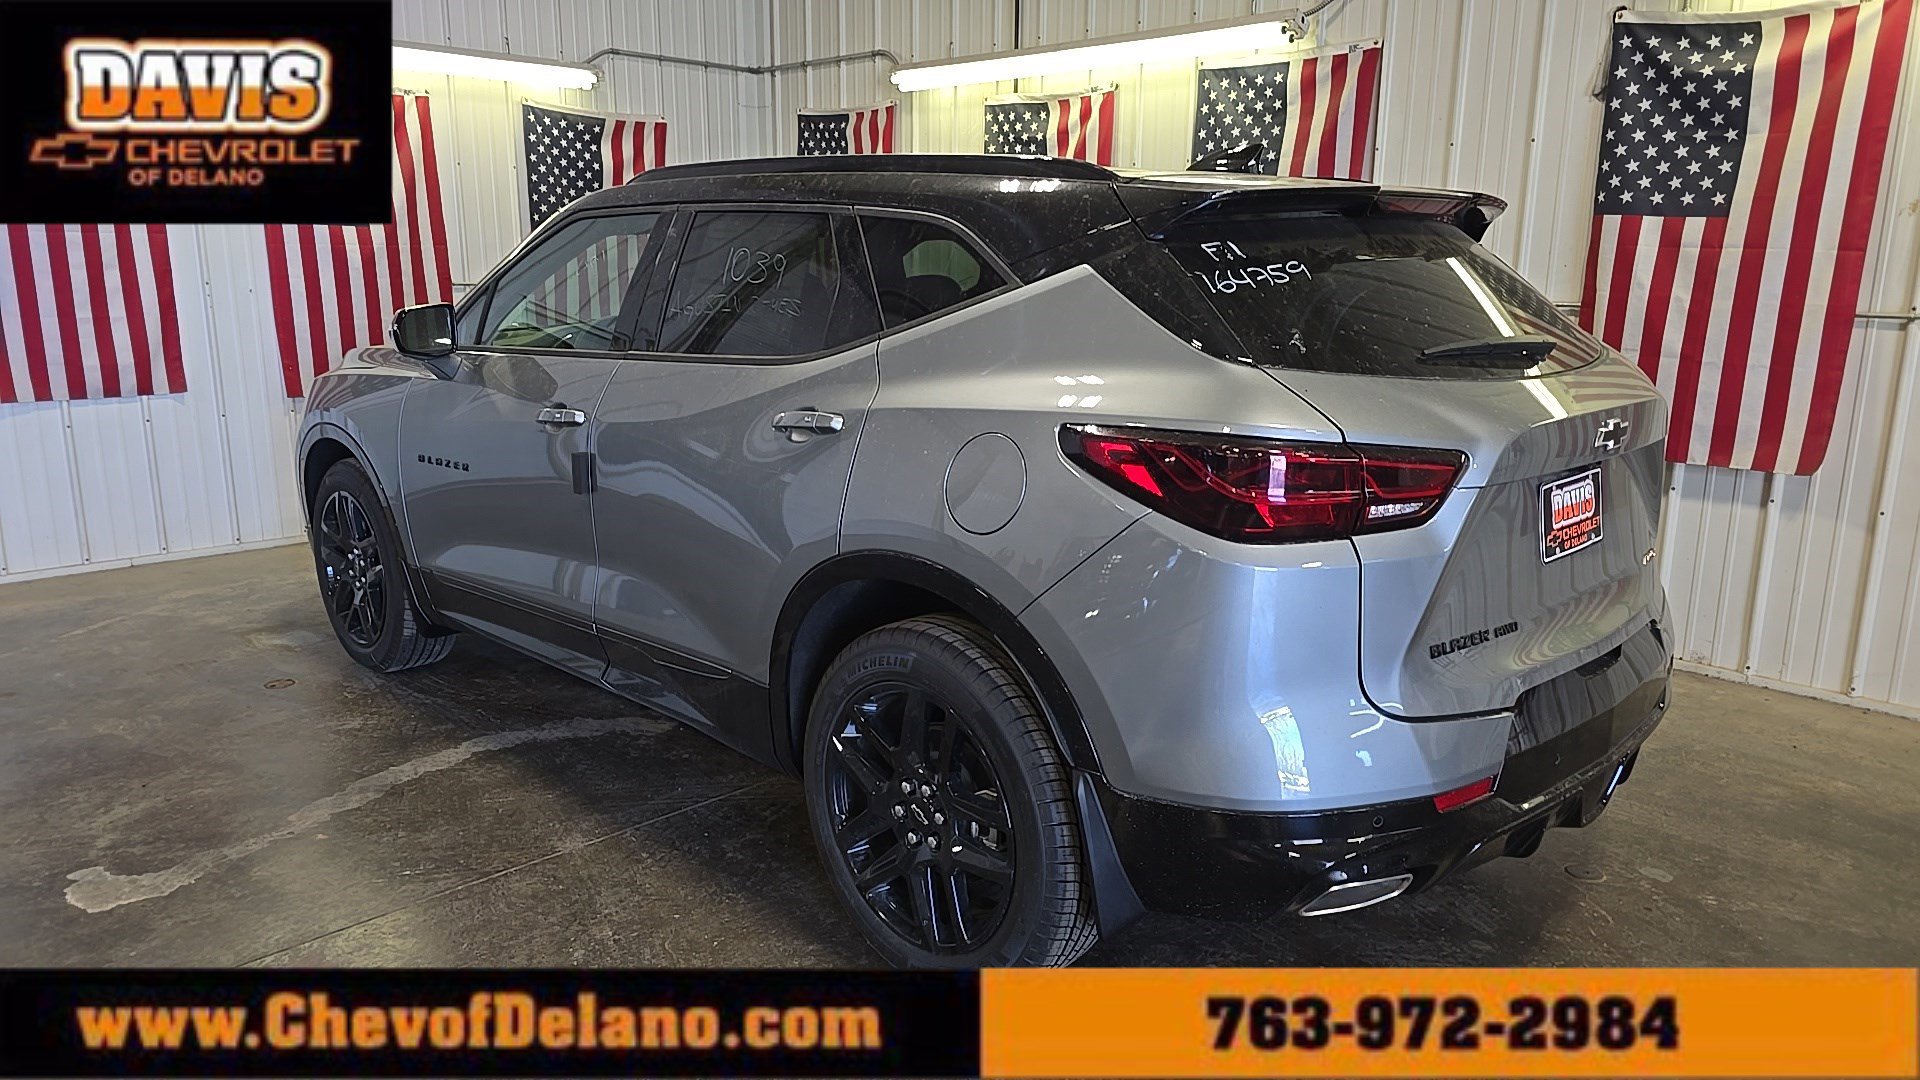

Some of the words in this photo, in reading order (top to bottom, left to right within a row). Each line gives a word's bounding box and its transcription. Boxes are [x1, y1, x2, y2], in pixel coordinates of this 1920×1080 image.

[722, 247, 788, 290] 1039
[1194, 260, 1312, 293] 164759
[417, 453, 470, 473] BLAZER
[1552, 483, 1593, 525] DAVIS
[1563, 516, 1600, 540] CHEVROLET
[1429, 628, 1490, 660] BLAZER
[843, 654, 910, 679] MICHELIN
